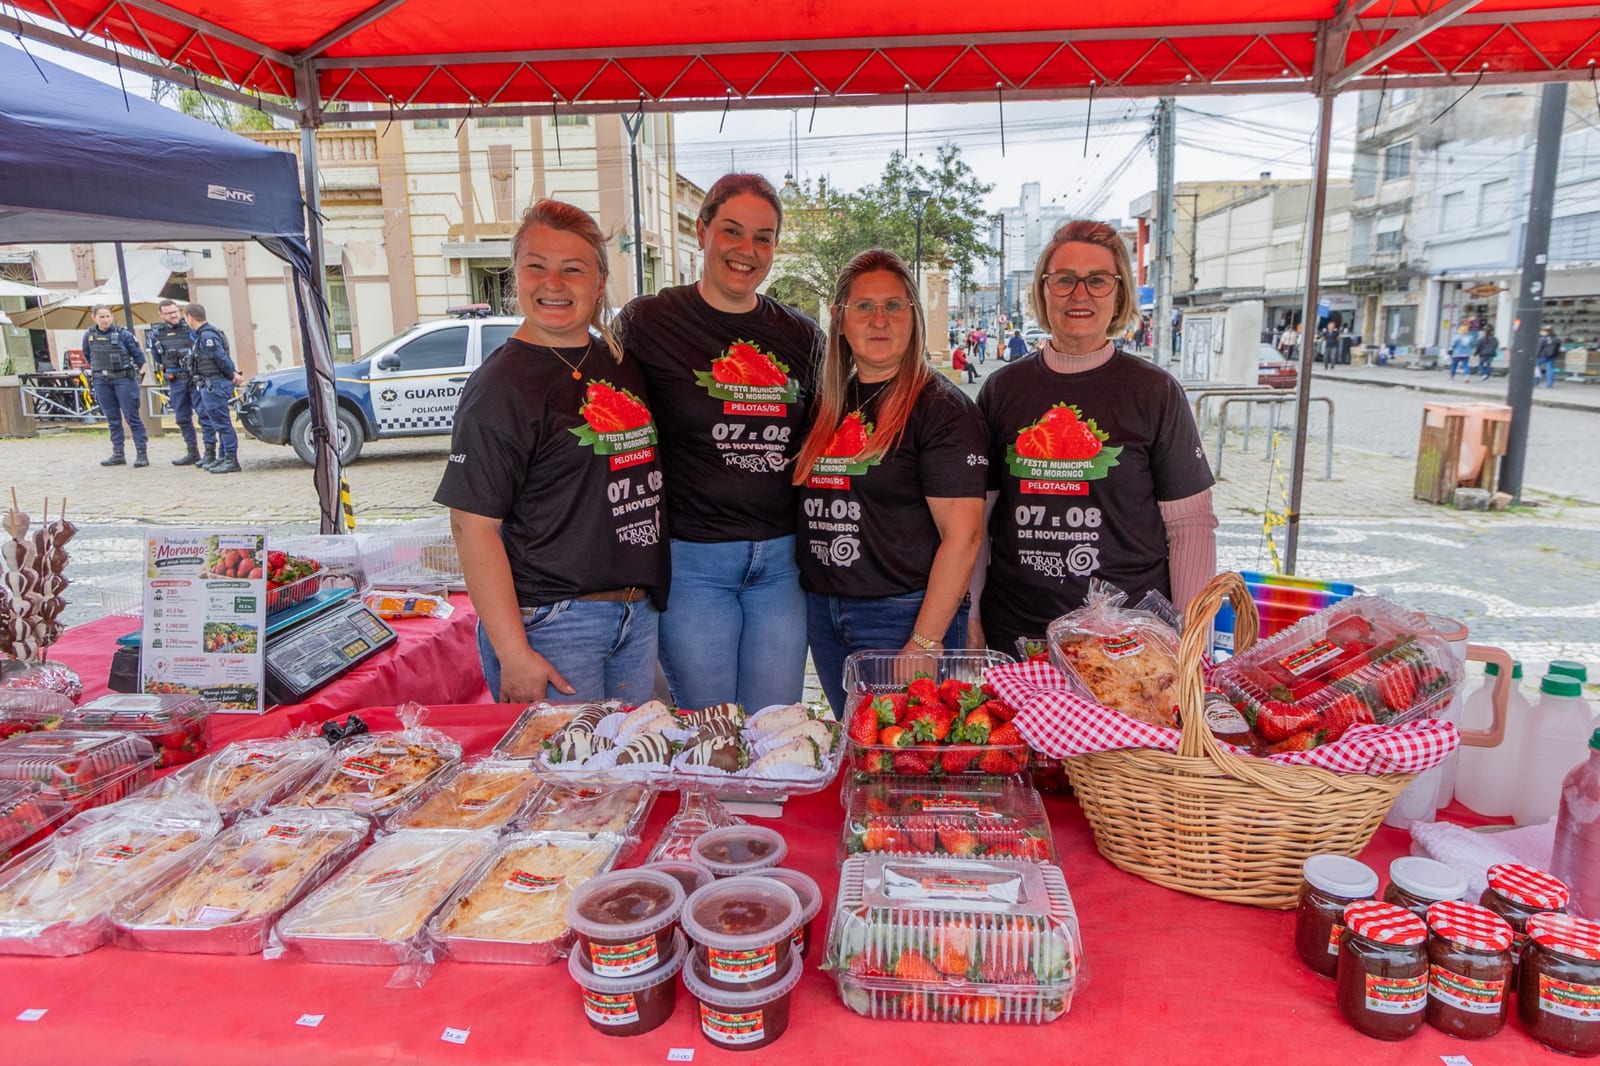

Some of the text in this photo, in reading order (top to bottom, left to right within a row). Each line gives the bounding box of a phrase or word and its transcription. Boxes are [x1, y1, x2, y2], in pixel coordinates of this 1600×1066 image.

[226, 190, 254, 202] NTK
[731, 403, 780, 412] PELOTAS/RS
[606, 431, 624, 442] FESTA
[625, 425, 655, 440] MUNICIPAL
[712, 422, 791, 443] 07 E 08
[614, 442, 622, 451] DO
[716, 442, 786, 452] DE NOVEMBRO
[820, 464, 847, 473] MORANGO
[1023, 458, 1048, 468] FESTA
[1050, 461, 1095, 469] MUNICIPAL
[1044, 469, 1084, 478] MORANGO
[607, 470, 663, 503] 07 E 08
[1028, 482, 1081, 491] PELOTAS/RS
[612, 504, 626, 517] DE
[804, 498, 824, 517] 07
[831, 499, 861, 521] 08
[1015, 505, 1102, 528] 07 E 08
[618, 524, 657, 543] MORADA
[640, 531, 659, 547] SOL
[1018, 530, 1100, 541] DE NOVEMBRO
[157, 544, 205, 558] Morango
[1021, 555, 1065, 567] MORADA
[1044, 566, 1066, 577] SOL
[1375, 985, 1389, 993] Feira
[1550, 987, 1564, 996] Feira
[1564, 991, 1590, 1002] Municipal
